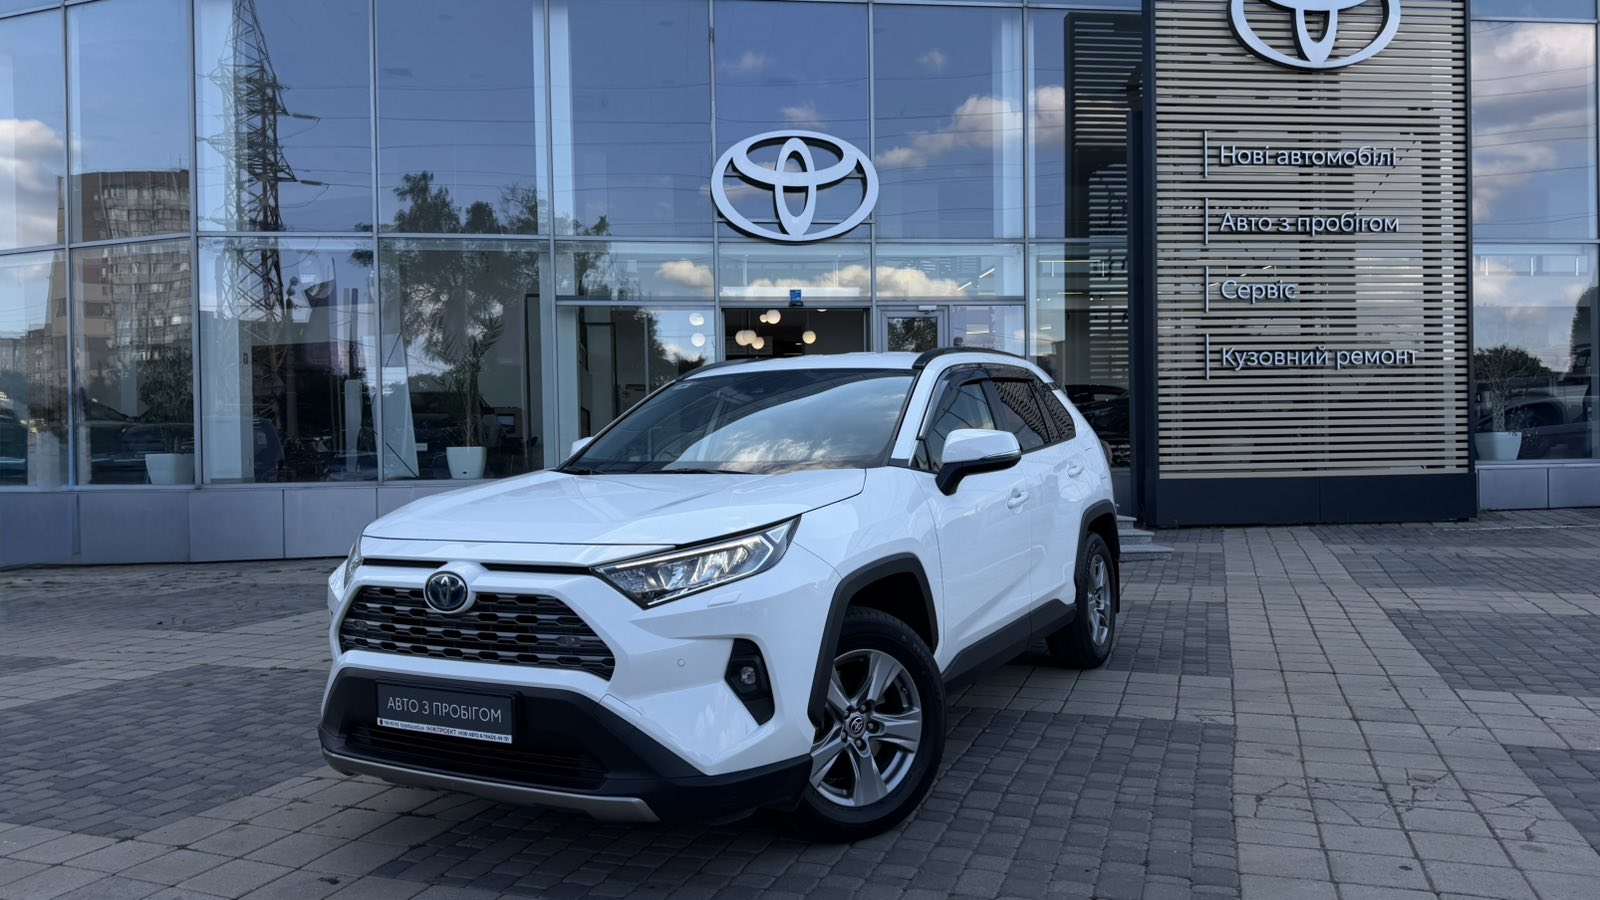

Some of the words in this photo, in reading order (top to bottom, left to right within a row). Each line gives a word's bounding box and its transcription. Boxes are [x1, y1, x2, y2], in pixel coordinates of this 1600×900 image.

[1219, 144, 1270, 165] Нові
[1277, 144, 1397, 166] автомобілі
[1219, 212, 1272, 232] Авто
[1278, 216, 1289, 232] з
[1297, 211, 1400, 237] пробігом
[1220, 279, 1297, 304] Сервіс
[1221, 346, 1330, 371] Кузовний
[1336, 350, 1419, 370] ремонт
[387, 697, 419, 713] АВТО
[422, 701, 430, 715] З
[433, 702, 502, 723] ПРОБІГОМ
